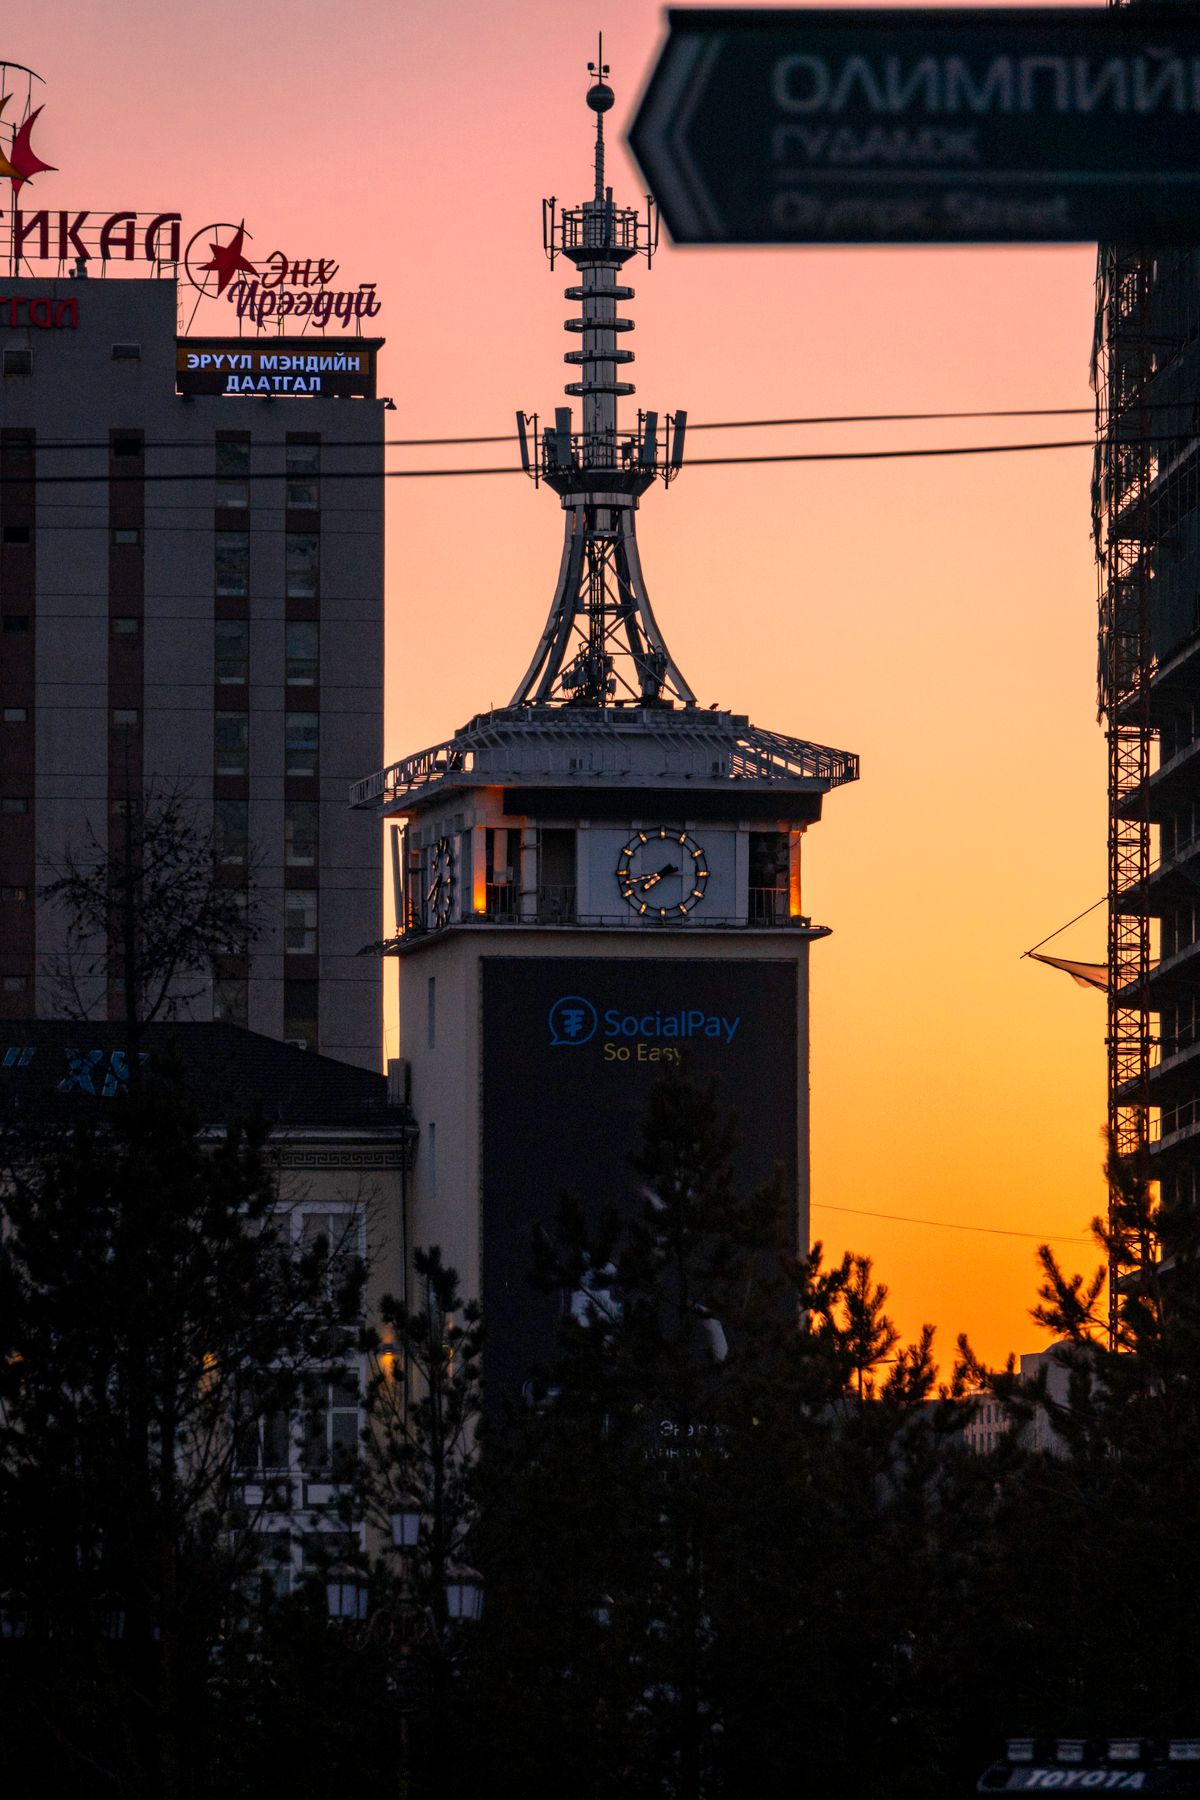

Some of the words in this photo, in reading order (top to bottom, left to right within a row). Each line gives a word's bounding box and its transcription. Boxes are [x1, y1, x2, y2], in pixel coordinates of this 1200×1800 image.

[0, 210, 181, 261] ИКАЛ
[259, 352, 360, 372] МЭНДИЙН
[226, 376, 321, 393] ДААТГАЛ
[603, 1009, 741, 1044] SocialPay
[603, 1043, 631, 1061] So
[1026, 1769, 1146, 1789] TOYOTA
